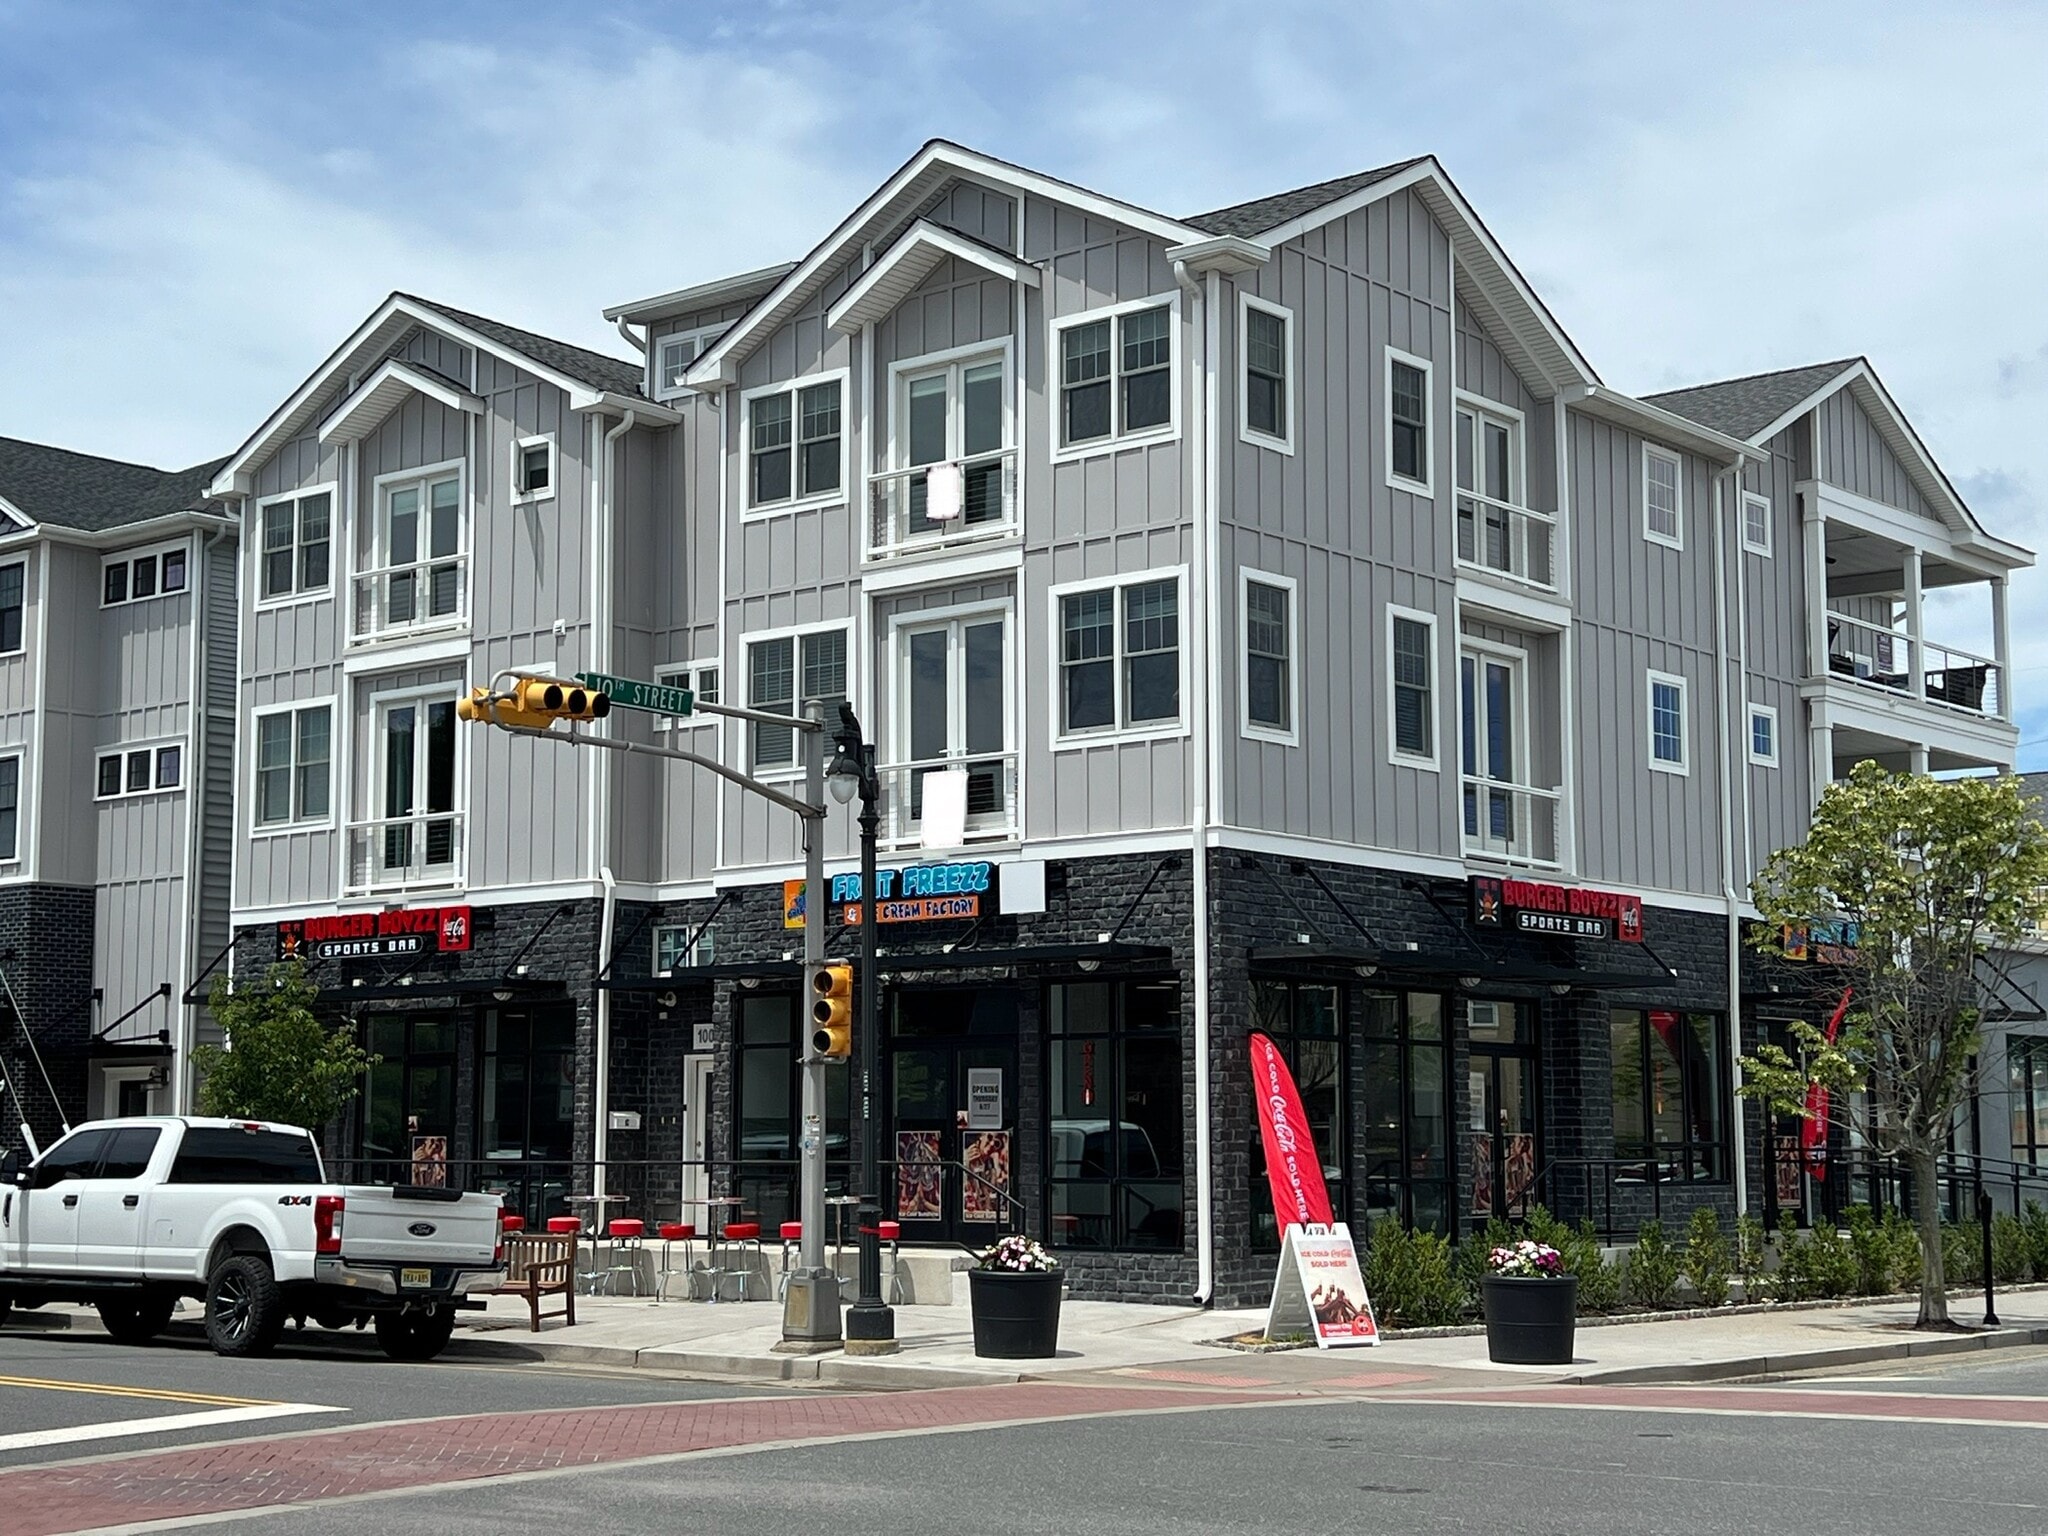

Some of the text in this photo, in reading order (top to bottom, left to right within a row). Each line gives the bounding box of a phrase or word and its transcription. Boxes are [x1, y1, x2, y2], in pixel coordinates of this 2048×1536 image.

[633, 684, 685, 712] STREET
[832, 862, 991, 902] FRIT FREEZZ
[883, 902, 921, 919] CREAM
[926, 899, 975, 916] FACTORY
[1503, 880, 1618, 918] BURGER BOYZZ
[305, 908, 437, 942] BURGER BOYZZ
[1521, 914, 1601, 935] SPORTS BAR
[324, 938, 417, 957] SPORTS BAR
[1265, 1042, 1274, 1061] ICE
[972, 1085, 999, 1094] OPENING
[1268, 1062, 1280, 1093] COLD
[1286, 1155, 1301, 1189] SOLD
[1294, 1188, 1310, 1223] HERE
[1311, 1260, 1328, 1268] SOLD
